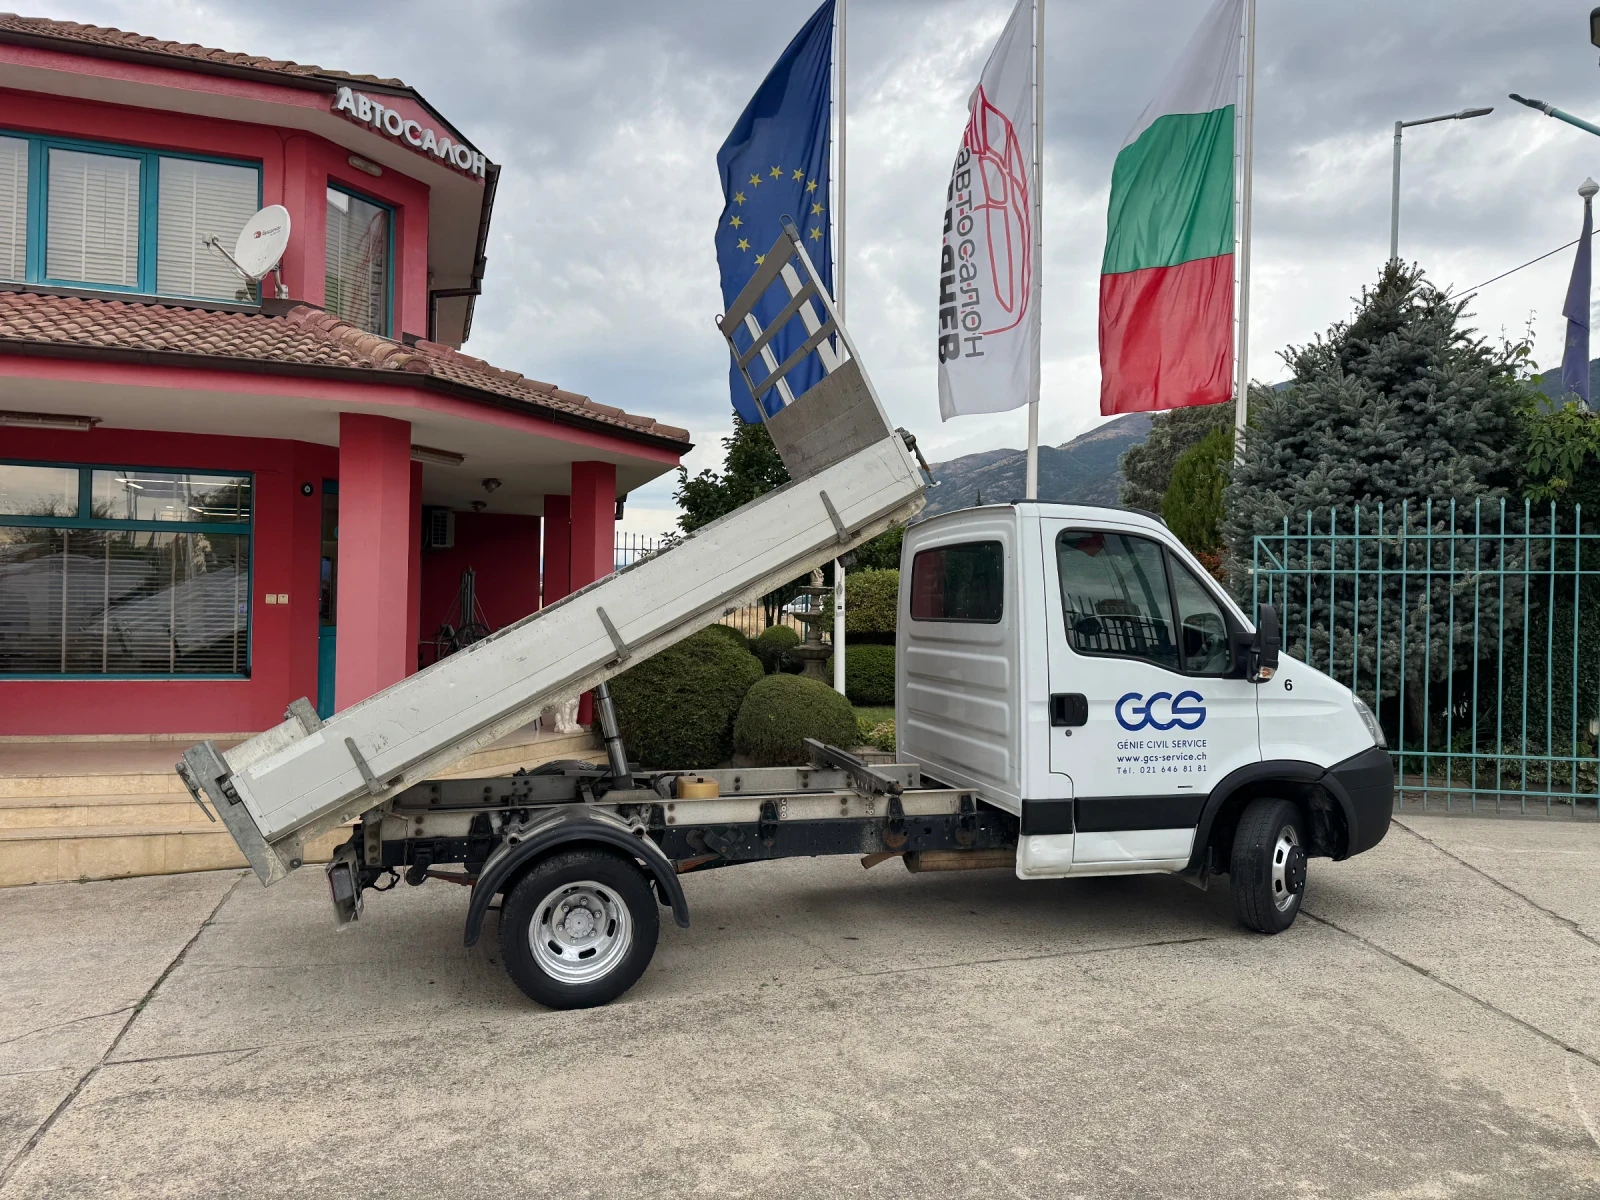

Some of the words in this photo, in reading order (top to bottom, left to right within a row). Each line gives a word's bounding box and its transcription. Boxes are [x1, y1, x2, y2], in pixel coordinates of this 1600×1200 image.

[333, 86, 486, 178] АВТОСАЛОН
[1284, 679, 1293, 692] 6
[1115, 690, 1207, 731] GCS
[1117, 739, 1144, 750] GÉNIE
[1146, 740, 1169, 749] CIVIL
[1172, 739, 1207, 748] SERVICE
[1117, 752, 1207, 764] www.gcs-service.ch
[1140, 766, 1156, 774] 021
[1161, 765, 1178, 773] 646
[1183, 765, 1193, 773] 81
[1197, 764, 1207, 772] 81
